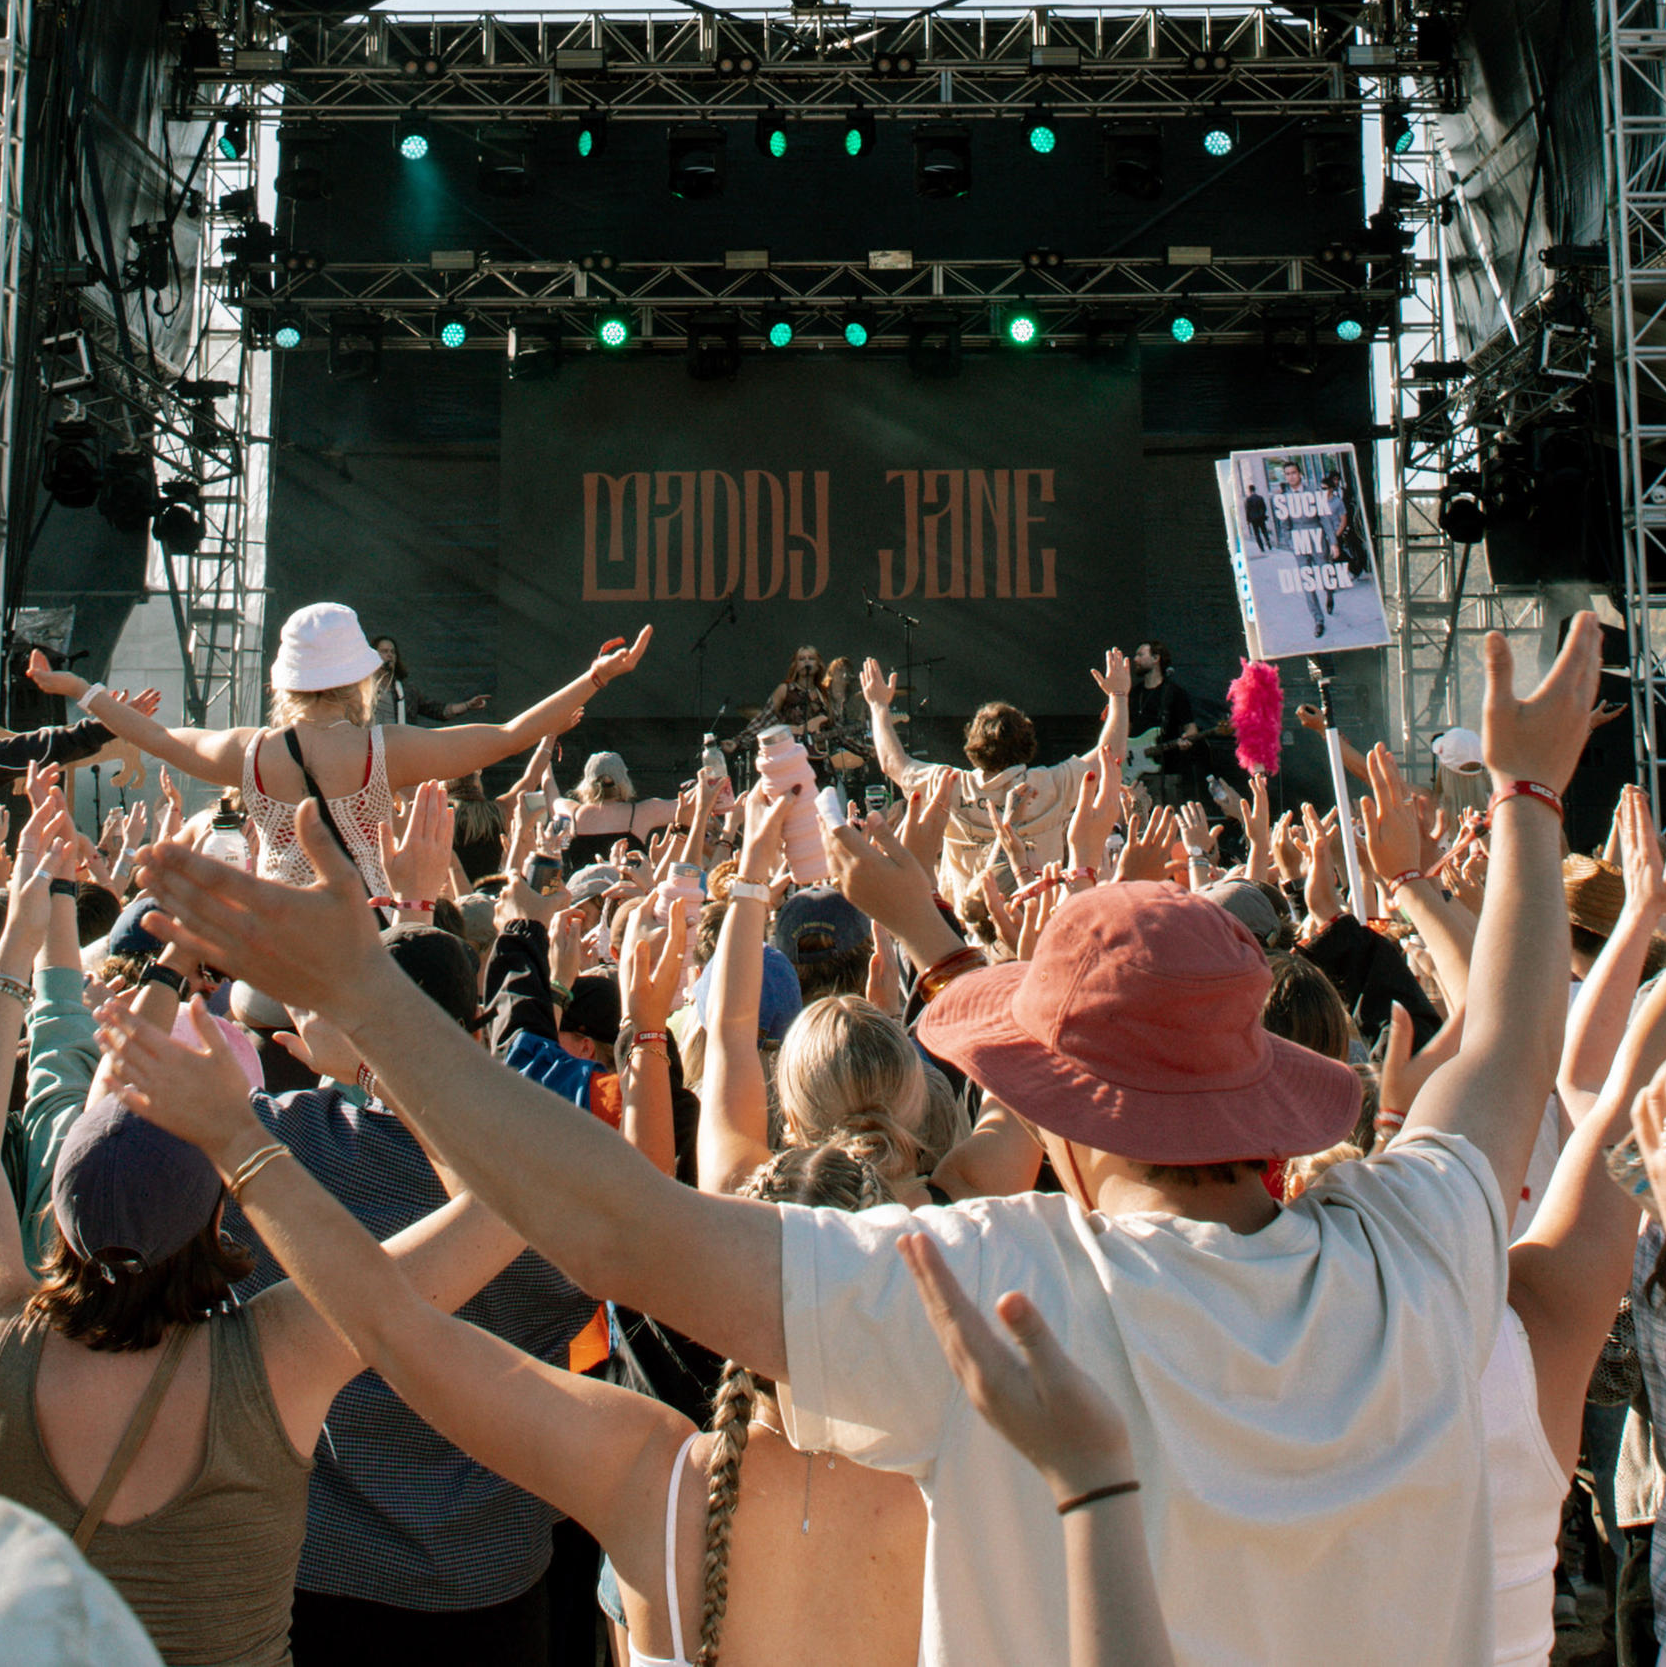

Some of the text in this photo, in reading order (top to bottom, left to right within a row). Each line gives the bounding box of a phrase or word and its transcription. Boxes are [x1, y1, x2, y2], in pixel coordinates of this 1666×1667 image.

[1273, 490, 1332, 520] SUCK
[1291, 528, 1323, 556] MY
[1278, 562, 1354, 594] DISICK
